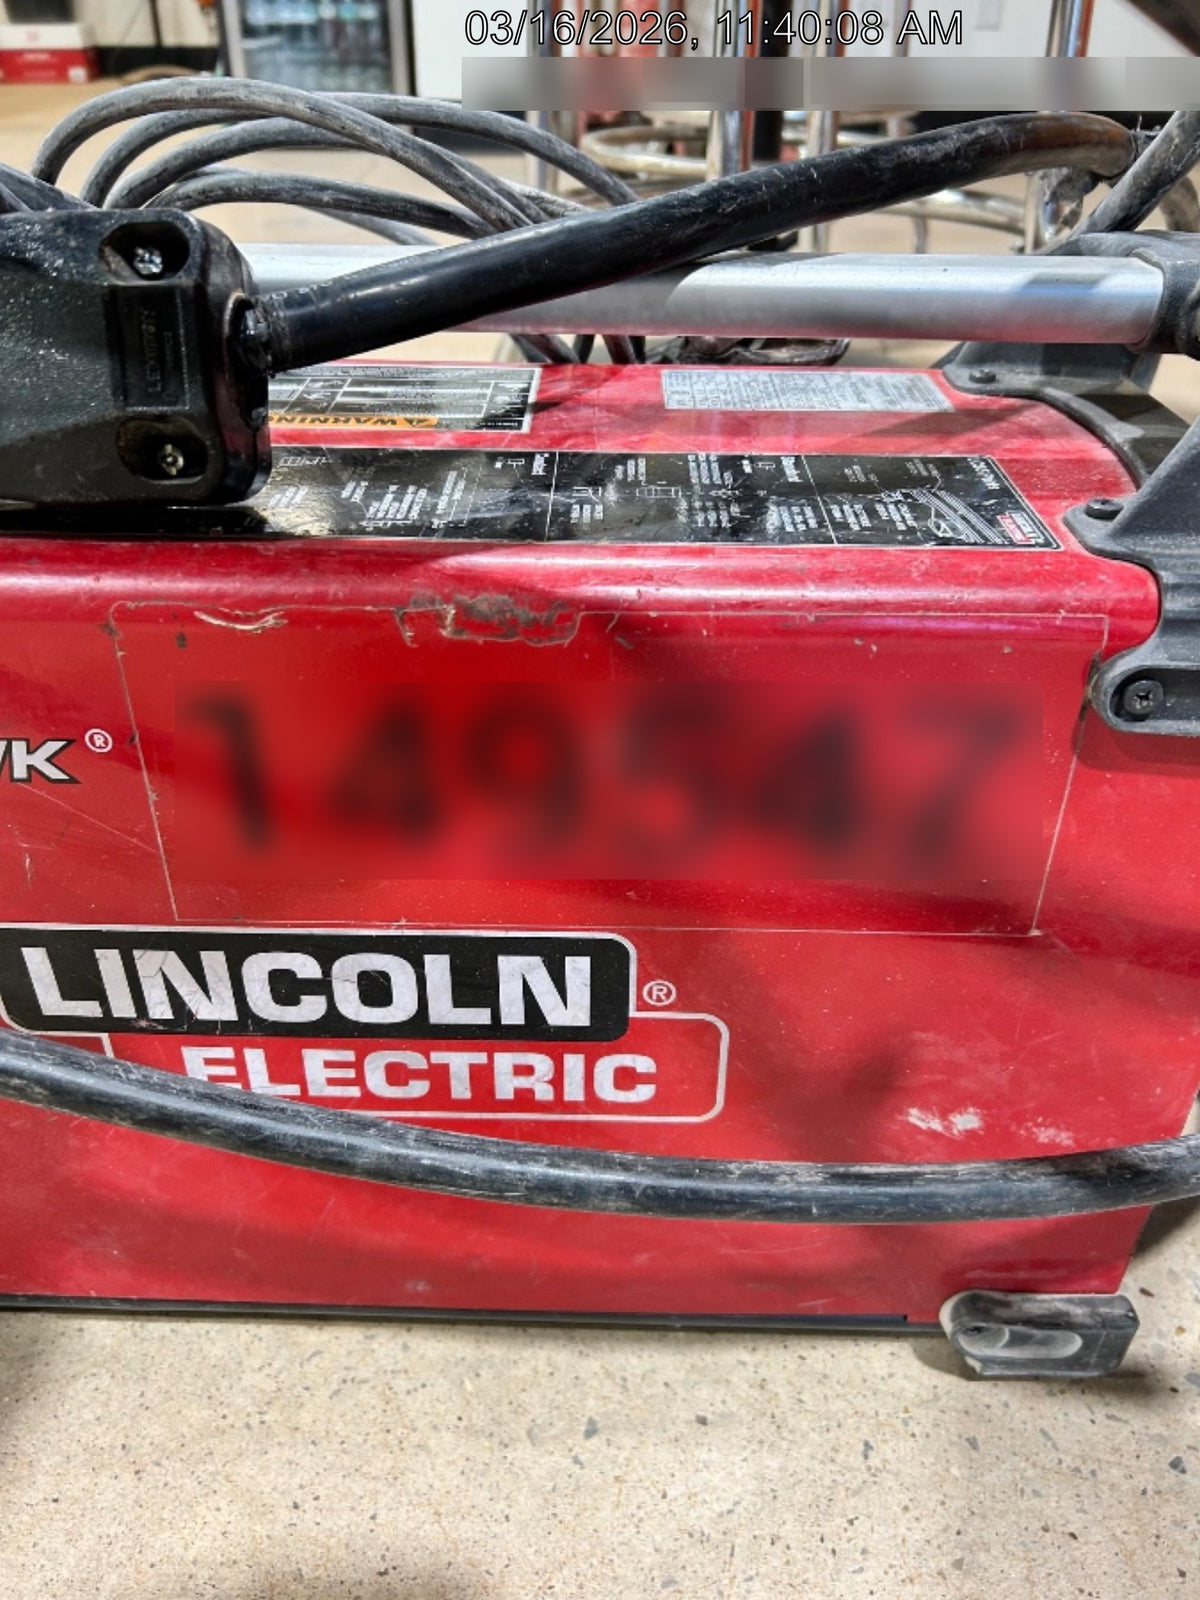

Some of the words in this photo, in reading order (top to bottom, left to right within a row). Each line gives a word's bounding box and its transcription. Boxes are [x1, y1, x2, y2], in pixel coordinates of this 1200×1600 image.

[269, 415, 397, 426] WARNIN
[0, 738, 82, 784] K
[20, 946, 593, 1028] LINCOLN
[181, 1047, 658, 1104] ELECTRIC
